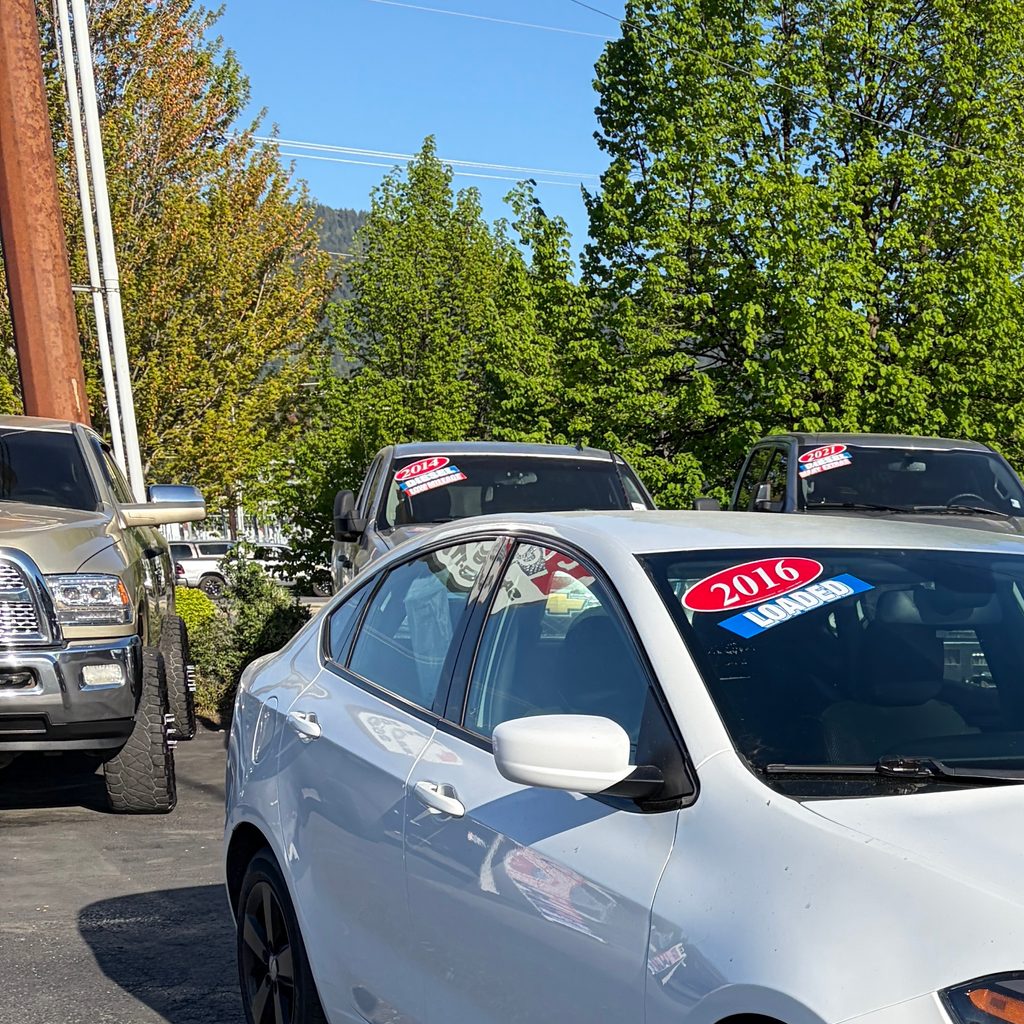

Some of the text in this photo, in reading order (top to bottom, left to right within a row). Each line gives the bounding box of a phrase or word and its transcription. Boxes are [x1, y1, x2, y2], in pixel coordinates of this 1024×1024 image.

[402, 458, 440, 479] 2014
[808, 446, 836, 461] 2021
[710, 559, 800, 607] 2016
[742, 579, 855, 629] LOADED
